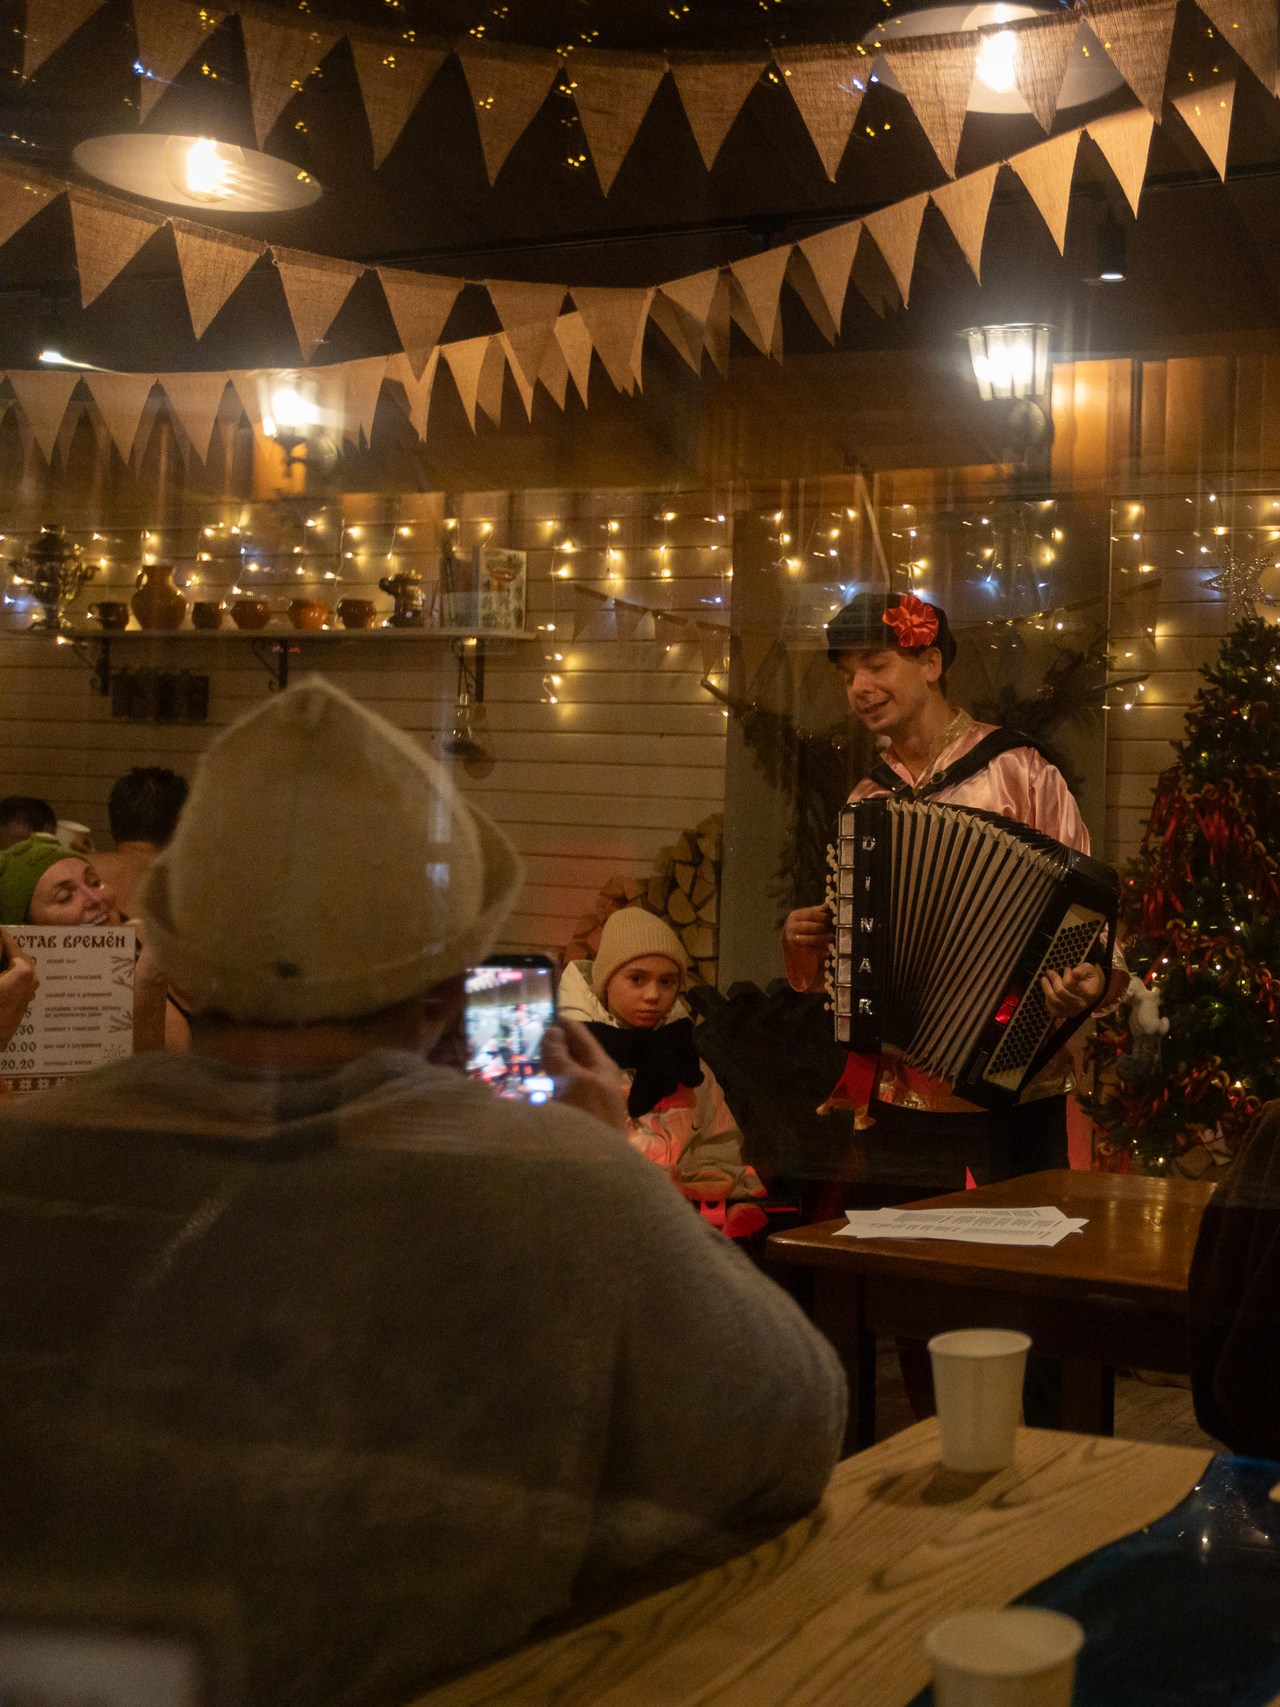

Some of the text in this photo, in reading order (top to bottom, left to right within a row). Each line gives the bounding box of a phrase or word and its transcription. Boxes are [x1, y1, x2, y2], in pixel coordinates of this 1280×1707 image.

[859, 836, 877, 1016] DINAR
[13, 932, 126, 948] СТАВ ВРЕМЁН
[6, 1041, 36, 1052] 0.00
